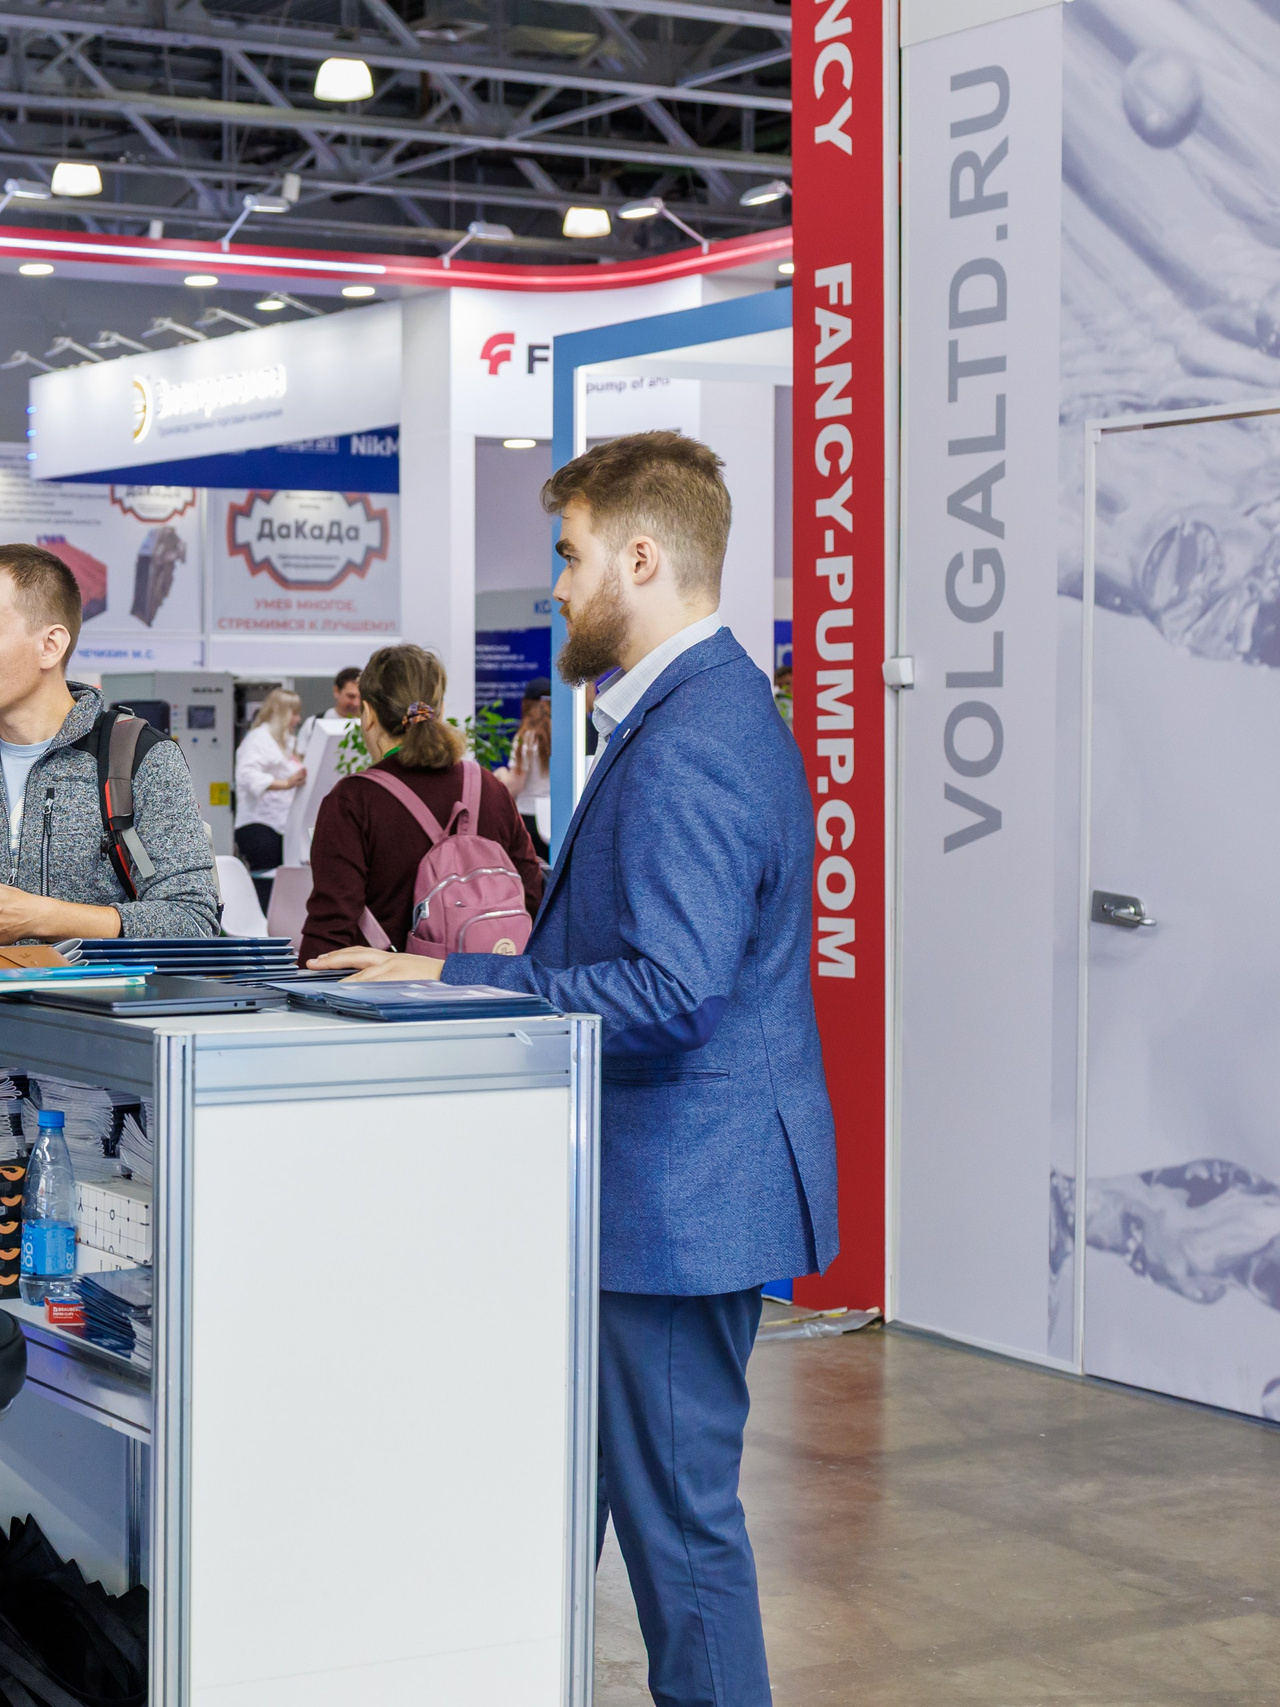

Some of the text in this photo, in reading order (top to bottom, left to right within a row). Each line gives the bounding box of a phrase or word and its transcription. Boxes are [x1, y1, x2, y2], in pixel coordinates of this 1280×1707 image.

[585, 381, 627, 396] pump
[943, 64, 1011, 855] VOLGALTD.RU
[256, 518, 361, 544] ДаКаДа
[217, 617, 305, 631] СТРЕМИМСЯ
[309, 619, 318, 630] К
[814, 262, 856, 980] FANCY-PUMP.COM
